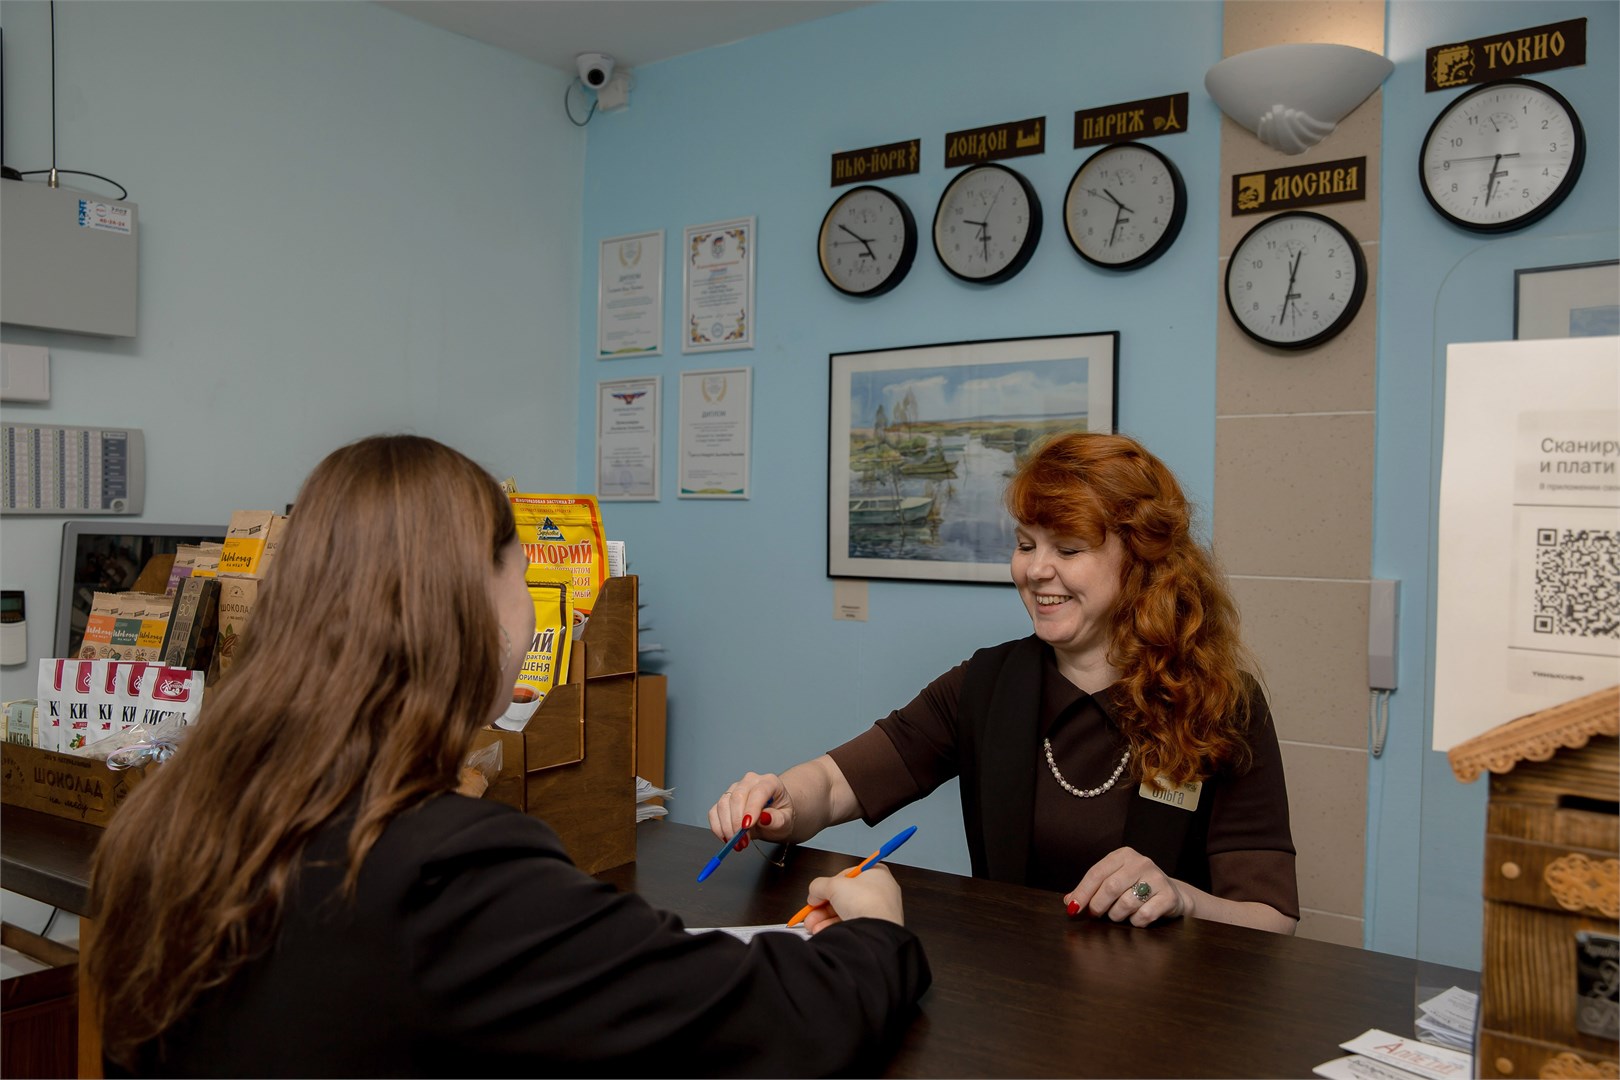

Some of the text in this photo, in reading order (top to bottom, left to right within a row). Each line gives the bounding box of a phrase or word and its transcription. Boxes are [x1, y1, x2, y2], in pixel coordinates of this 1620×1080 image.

[1484, 30, 1566, 69] ТОКИО
[1522, 106, 1528, 114] 1
[1083, 108, 1145, 140] ПАРИЖ
[1468, 116, 1479, 125] 11
[1541, 120, 1549, 130] 2
[948, 129, 1008, 159] ЛОНДОН
[1450, 137, 1463, 148] 10
[1550, 143, 1557, 153] 3
[836, 149, 906, 178] НЬЮ-ЙОРК
[1139, 164, 1144, 172] 1
[1443, 161, 1450, 171] 9
[1100, 170, 1108, 178] 11
[1541, 168, 1550, 177] 4
[1152, 177, 1158, 185] 2
[1271, 166, 1358, 201] МОСКВА
[1451, 183, 1458, 192] 8
[1522, 188, 1530, 198] 5
[1158, 196, 1164, 204] 3
[1472, 197, 1479, 206] 7
[1082, 208, 1088, 217] 9
[1088, 227, 1094, 236] 8
[1139, 234, 1144, 242] 5
[1313, 235, 1318, 243] 1
[1267, 241, 1276, 249] 11
[1328, 250, 1336, 258] 2
[1252, 260, 1262, 268] 10
[1335, 270, 1342, 280] 3
[1246, 282, 1252, 290] 9
[1329, 293, 1336, 301] 4
[1253, 302, 1260, 311] 8
[1270, 316, 1276, 324] 7
[1312, 311, 1319, 320] 5
[1540, 461, 1615, 474] и плати
[34, 766, 104, 799] ШОКОЛАД
[64, 794, 88, 818] меду
